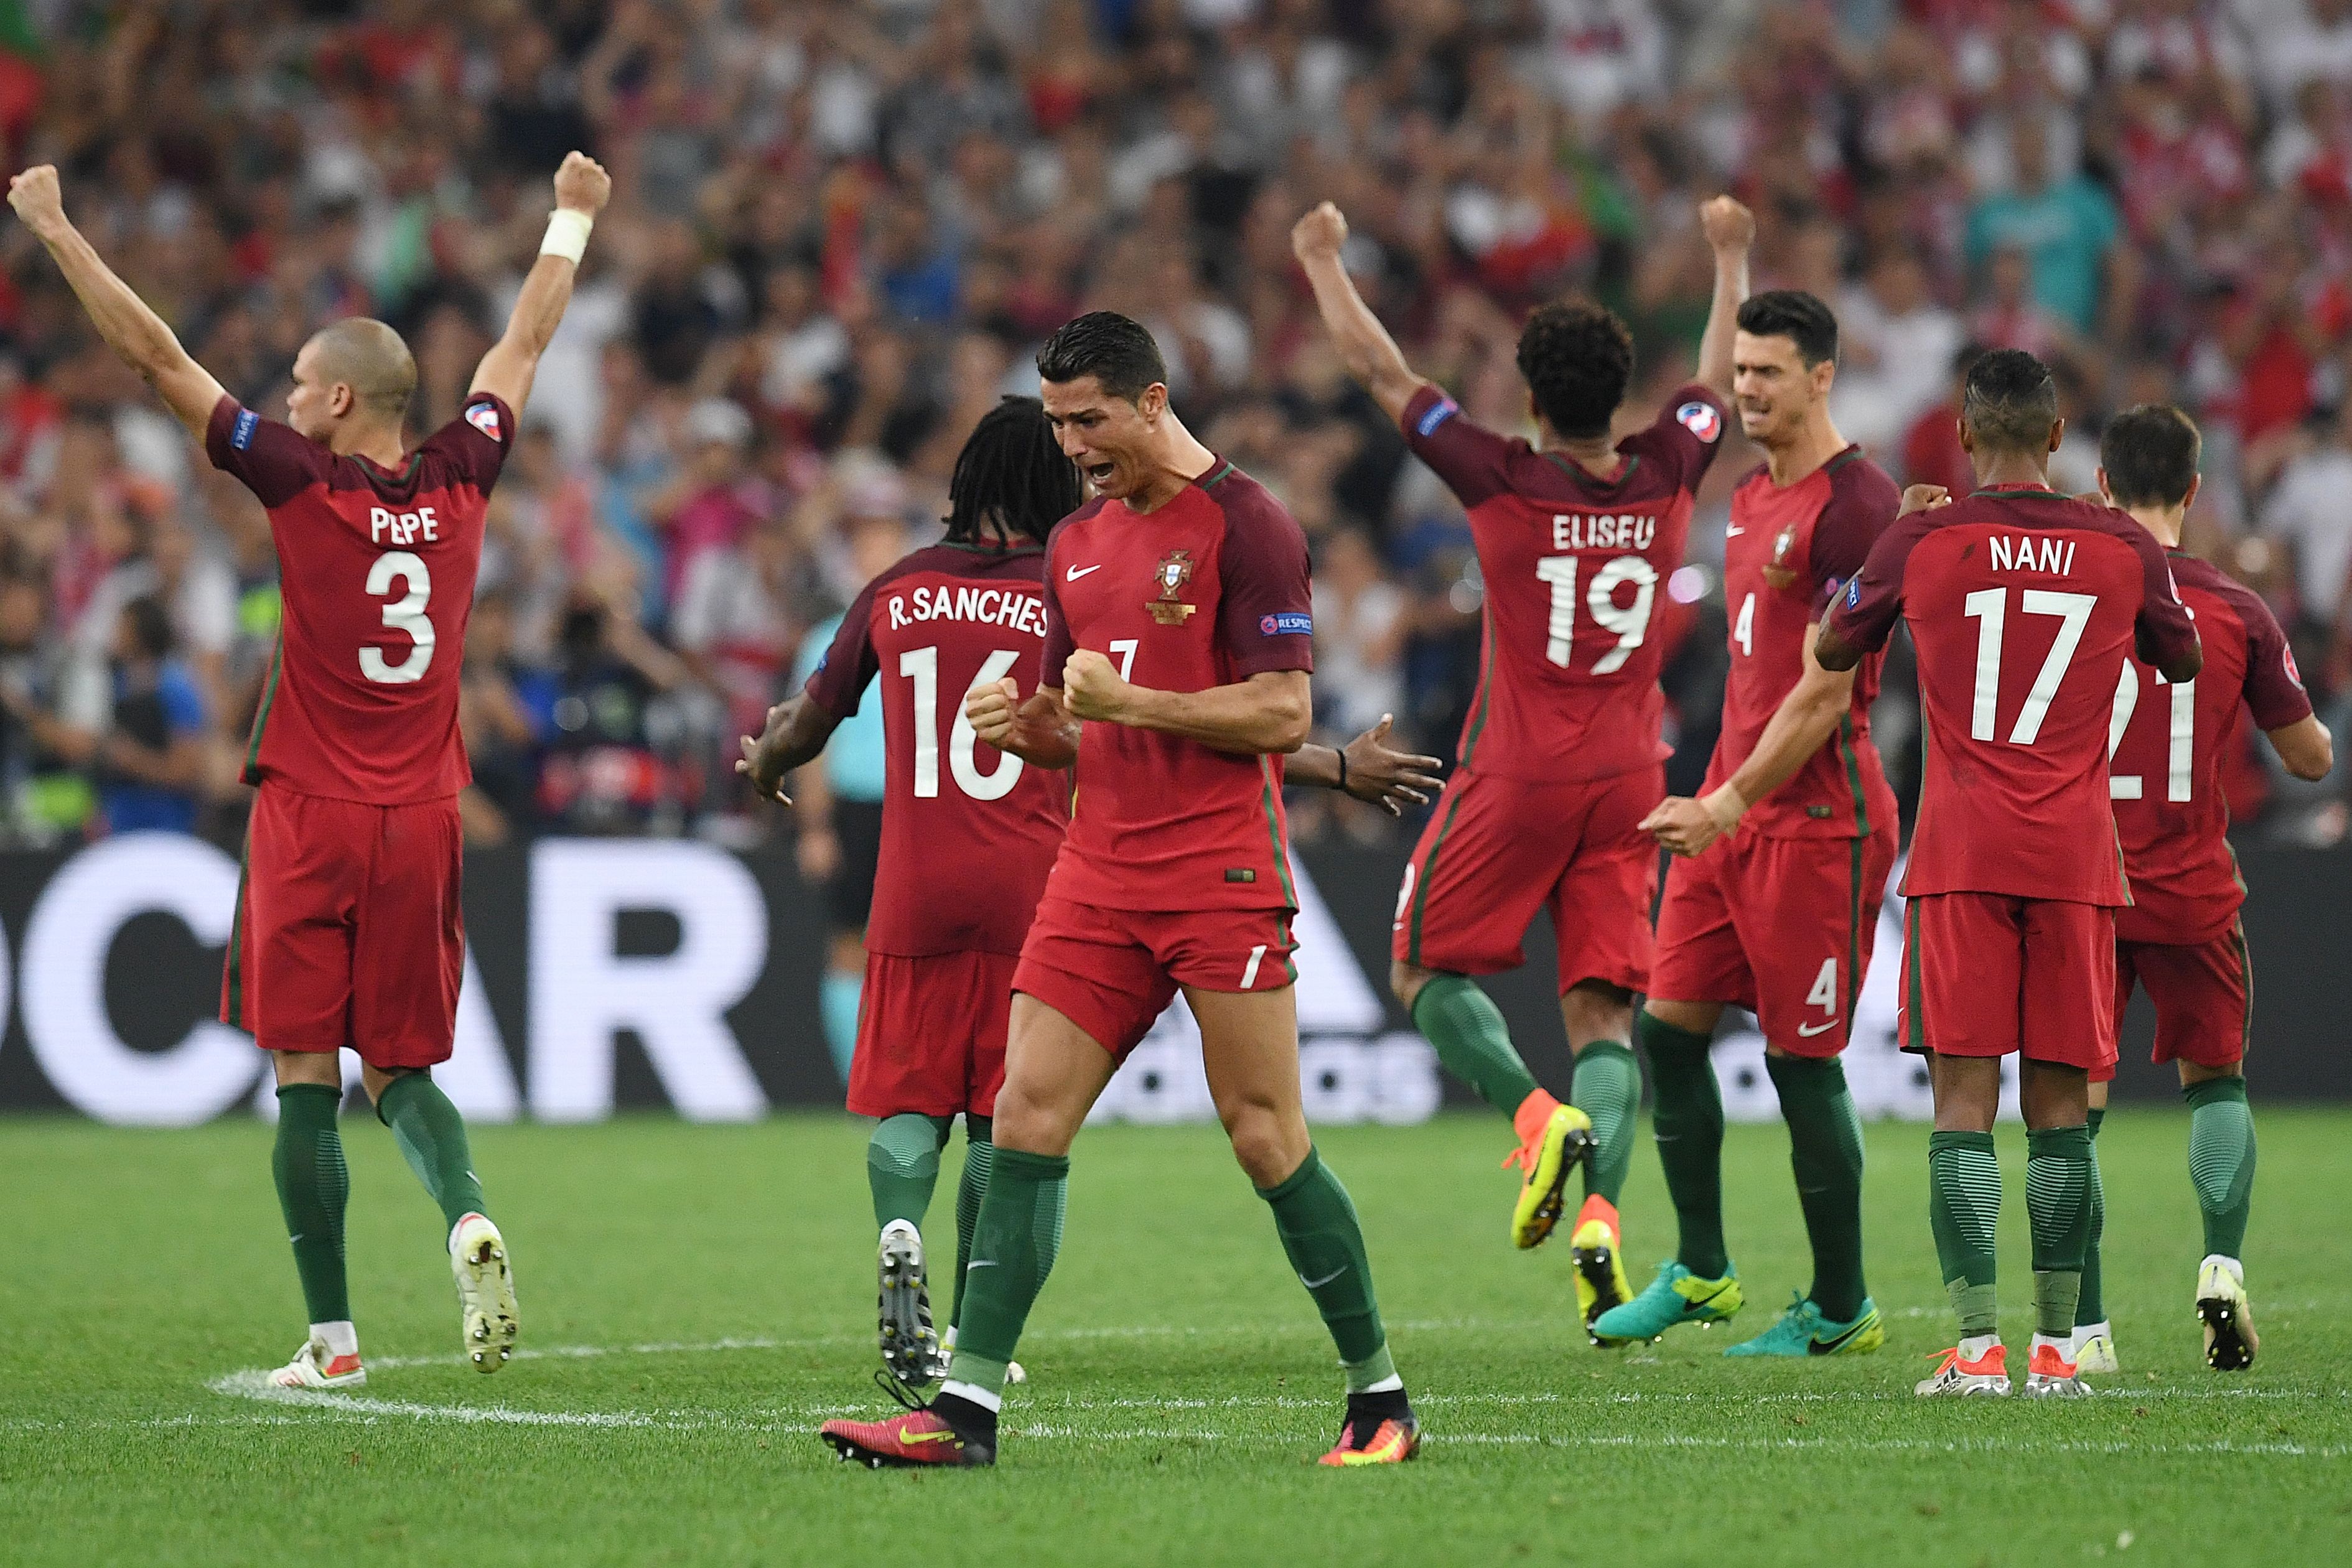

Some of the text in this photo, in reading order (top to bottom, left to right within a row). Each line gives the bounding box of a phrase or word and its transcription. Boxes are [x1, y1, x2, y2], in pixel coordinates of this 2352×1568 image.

[370, 506, 438, 545] PEPE
[1552, 514, 1655, 550] ELISEU
[1989, 536, 2076, 576] NANI
[358, 551, 436, 684] 3
[1536, 556, 1659, 675] 19
[1734, 592, 1755, 656] 4
[1109, 639, 1139, 683] 7
[1964, 587, 2098, 745] 17
[900, 646, 1024, 801] 16
[2108, 656, 2196, 803] 21
[1806, 957, 1837, 1016] 4
